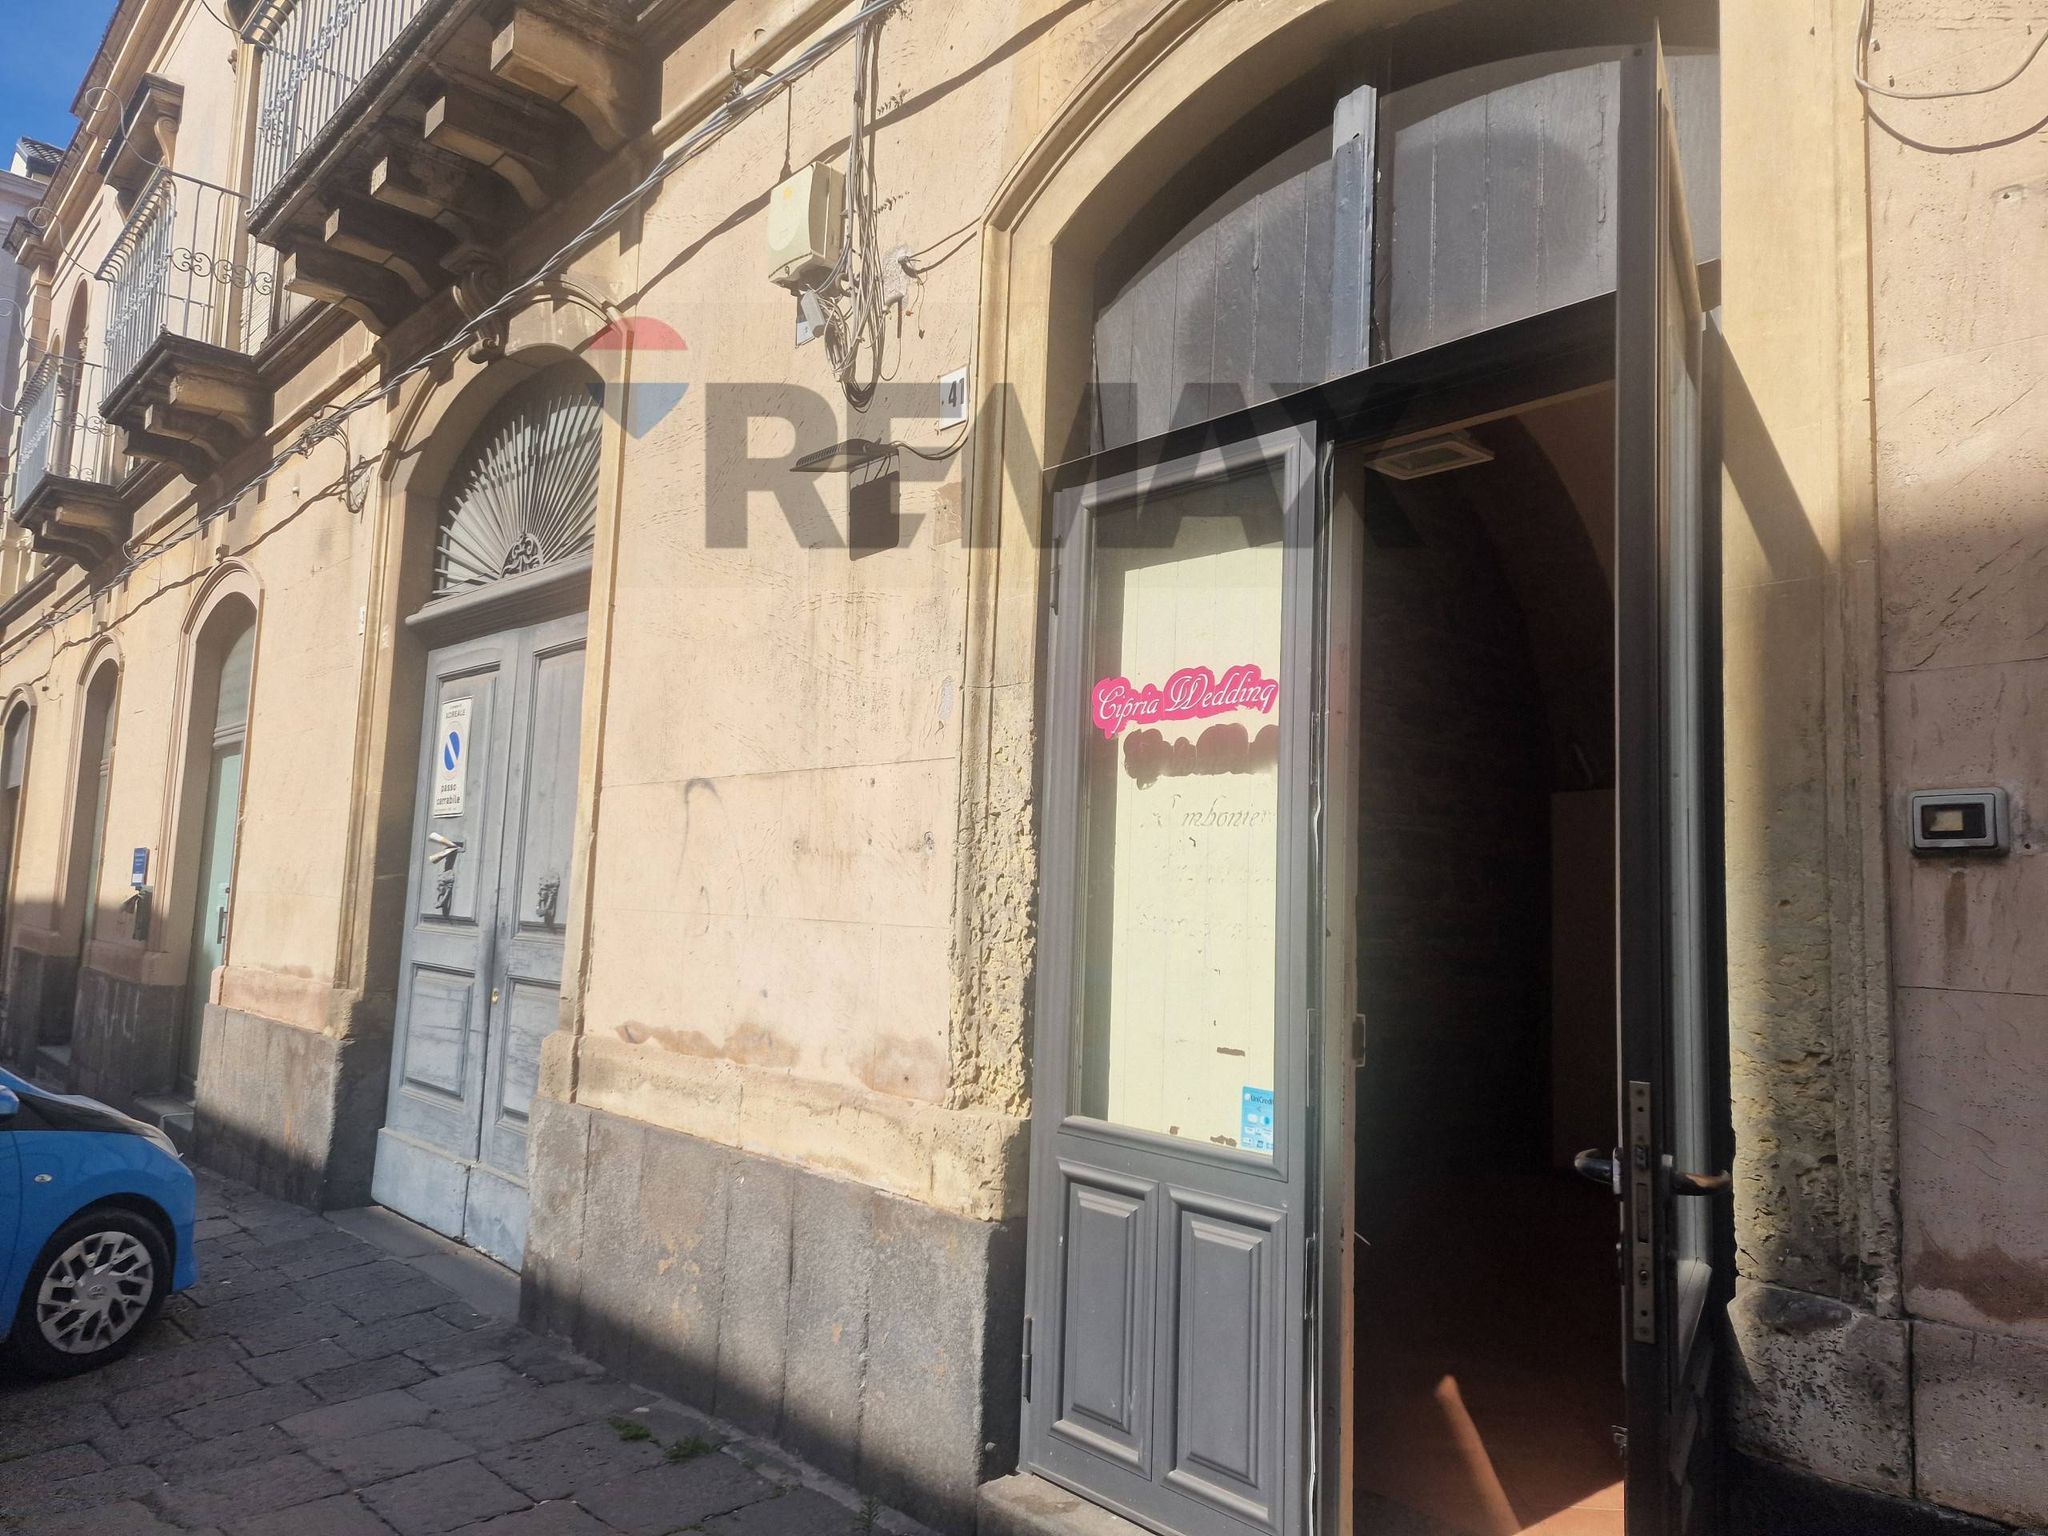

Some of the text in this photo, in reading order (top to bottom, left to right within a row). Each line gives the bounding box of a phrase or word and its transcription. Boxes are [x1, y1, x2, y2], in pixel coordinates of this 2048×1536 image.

[1098, 670, 1277, 734] Cipria Wedding
[440, 783, 457, 793] passo
[436, 794, 461, 806] carrabile
